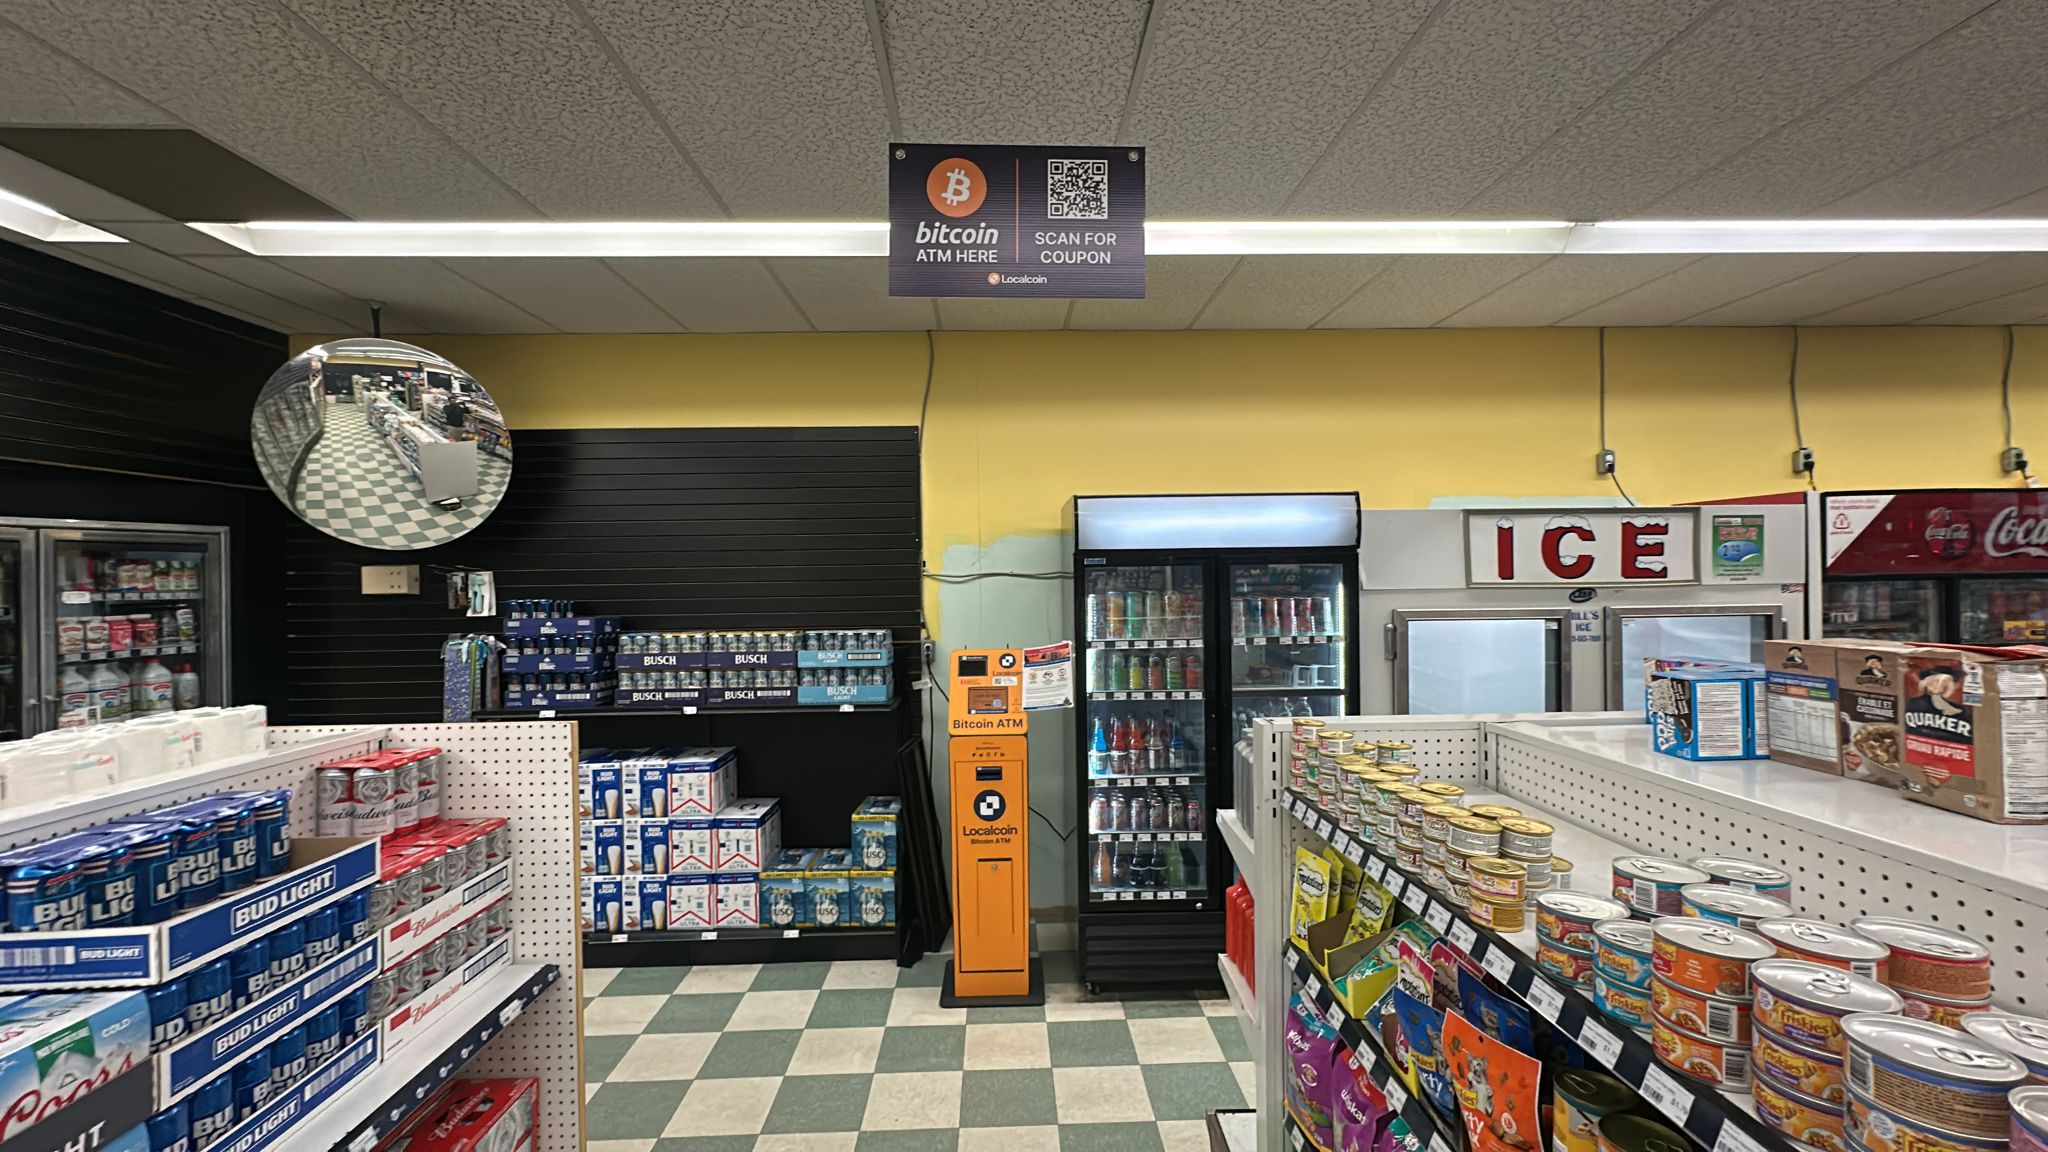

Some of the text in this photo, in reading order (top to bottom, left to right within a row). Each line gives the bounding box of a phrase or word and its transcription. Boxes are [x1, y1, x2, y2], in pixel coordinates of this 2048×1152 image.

[915, 221, 999, 245] bitcoin
[1034, 232, 1117, 246] SCAN FOR
[915, 249, 999, 263] ATM HERE
[1040, 250, 1112, 264] COUPON
[1001, 274, 1048, 284] Localcoin
[1984, 506, 2048, 557] Coca
[1496, 514, 1669, 580] ICE
[643, 656, 677, 666] BUSCH
[735, 654, 767, 664] BUSCH
[818, 652, 843, 660] BUSCH
[632, 692, 662, 701] BUSCH
[724, 691, 755, 700] BUSCH
[827, 686, 857, 696] BUSCH
[953, 719, 1024, 729] Bitcoin ATM
[1904, 711, 1972, 737] QUAKER
[962, 824, 1018, 836] Localcoin
[233, 835, 257, 856] BU
[865, 851, 885, 859] USC
[222, 850, 257, 873] LIG
[105, 876, 136, 901] BU
[236, 871, 333, 928] BUD LIGHT
[91, 893, 135, 922] LIG
[774, 908, 793, 916] USC
[411, 903, 462, 938] Budweiser
[79, 948, 140, 959] BUD LIGHT
[304, 934, 340, 958] BU
[272, 953, 304, 976] UD
[188, 990, 232, 1022] BU
[411, 983, 464, 1025] Budweiser
[1610, 993, 1646, 1014] Friskies
[101, 1018, 132, 1037] COLD
[152, 1018, 185, 1043] UD
[216, 996, 298, 1055] BUD LIGHT
[1780, 1007, 1830, 1034] Friskies
[306, 1034, 341, 1058] BU
[272, 1057, 307, 1082] UD
[1763, 1044, 1802, 1075] Friskies
[193, 1103, 234, 1139] BU
[254, 1100, 299, 1142] LIGHT
